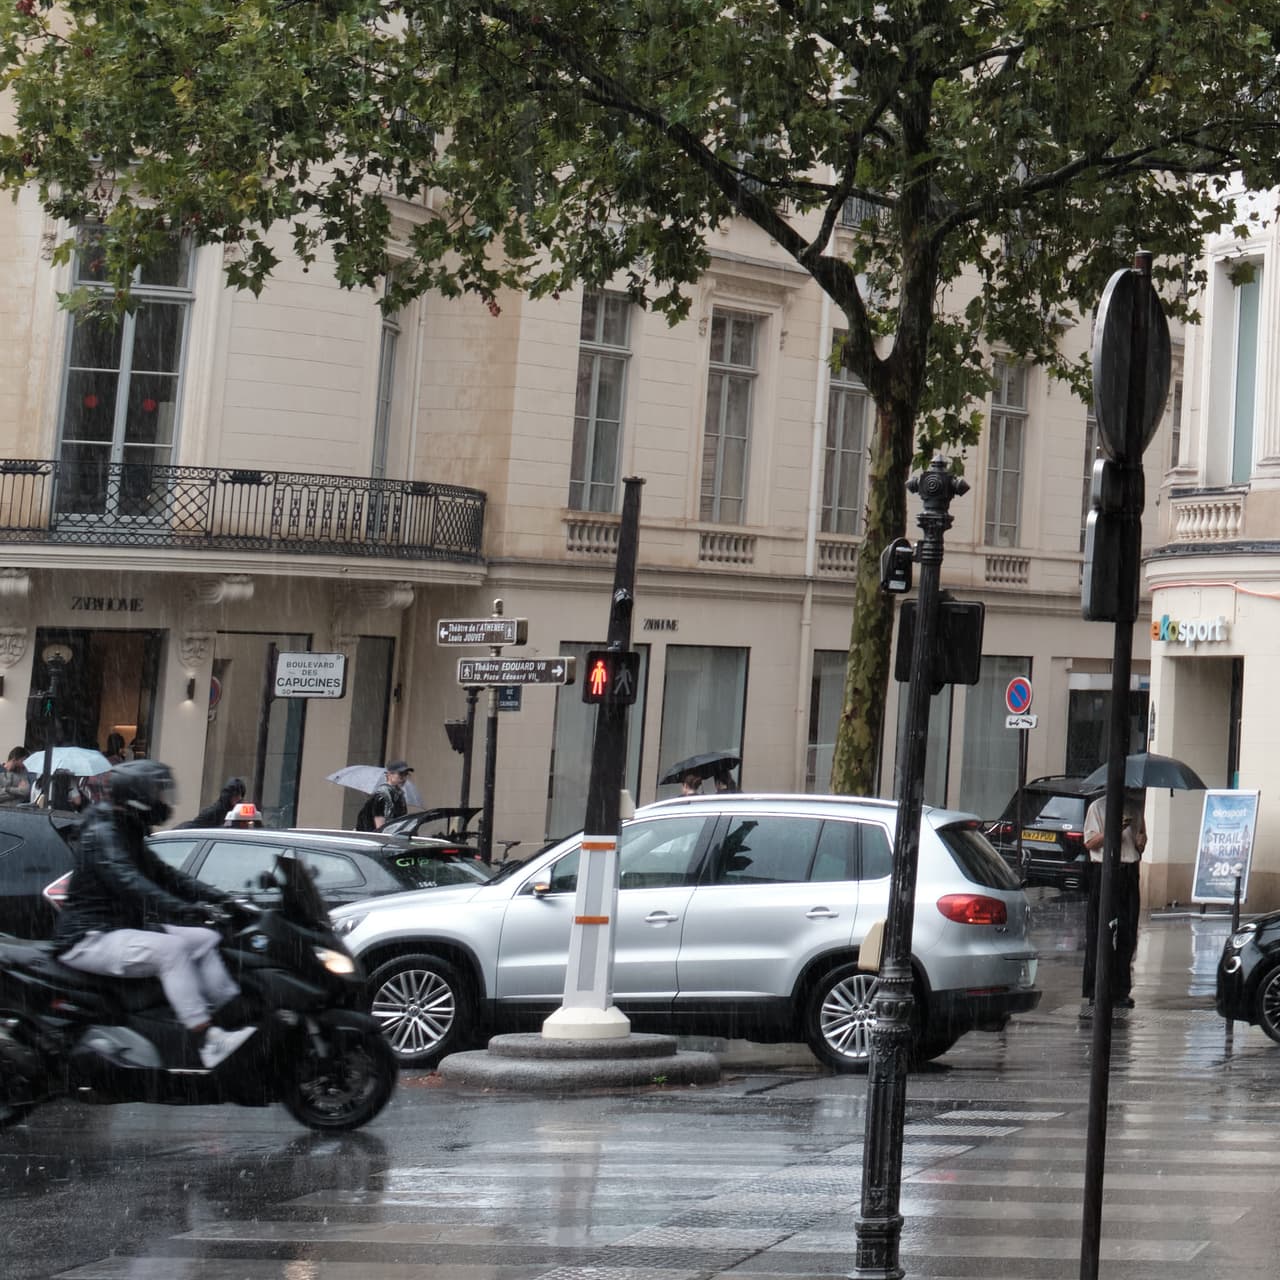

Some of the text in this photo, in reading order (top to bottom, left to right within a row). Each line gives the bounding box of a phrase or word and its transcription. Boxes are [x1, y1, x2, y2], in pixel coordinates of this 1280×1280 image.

[1150, 614, 1226, 649] ekosport
[463, 633, 486, 642] JOUVET
[286, 661, 335, 669] BOULEVARD
[474, 662, 499, 671] Théâtre
[501, 662, 534, 671] EDOUARD
[276, 677, 341, 688] CAPUCINES
[1213, 832, 1242, 844] TRAIL
[1219, 845, 1241, 857] RUN
